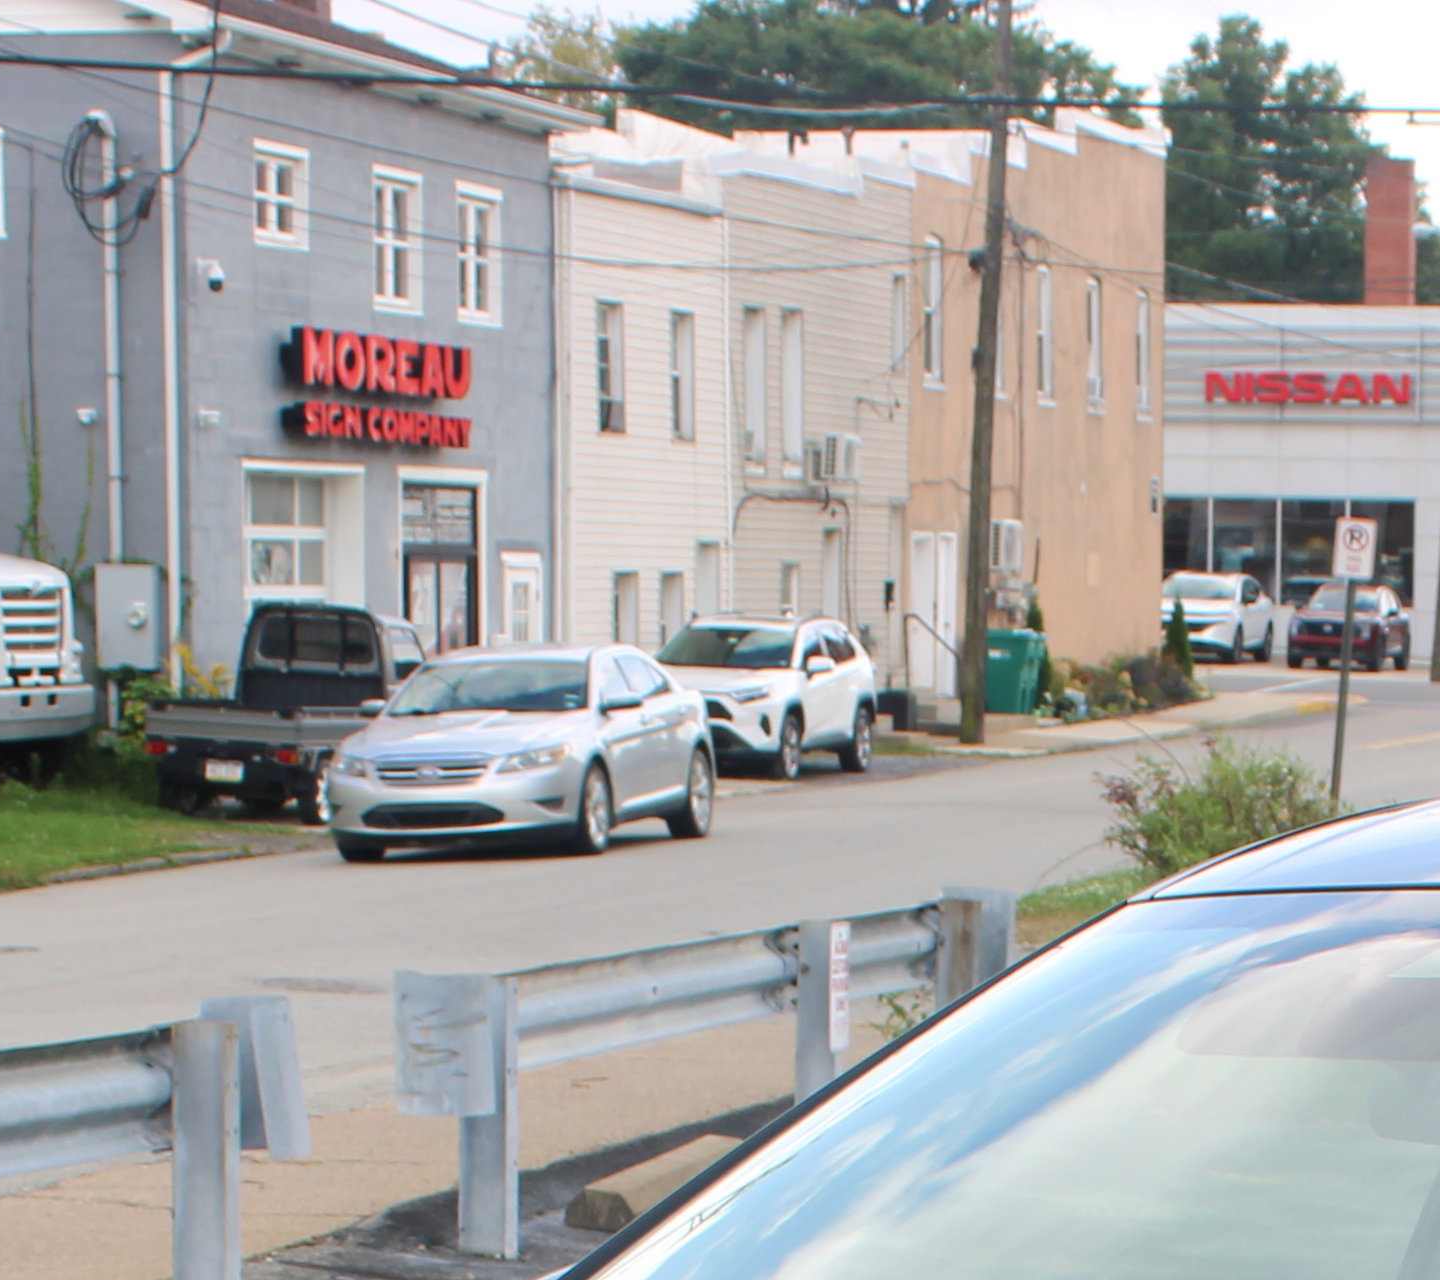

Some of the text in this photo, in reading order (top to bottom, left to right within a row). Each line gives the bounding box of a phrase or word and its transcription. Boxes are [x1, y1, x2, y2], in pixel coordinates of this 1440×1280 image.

[302, 325, 471, 398] MOREAU
[1204, 371, 1411, 404] NISSAN
[304, 400, 471, 448] SIGN COMPANY
